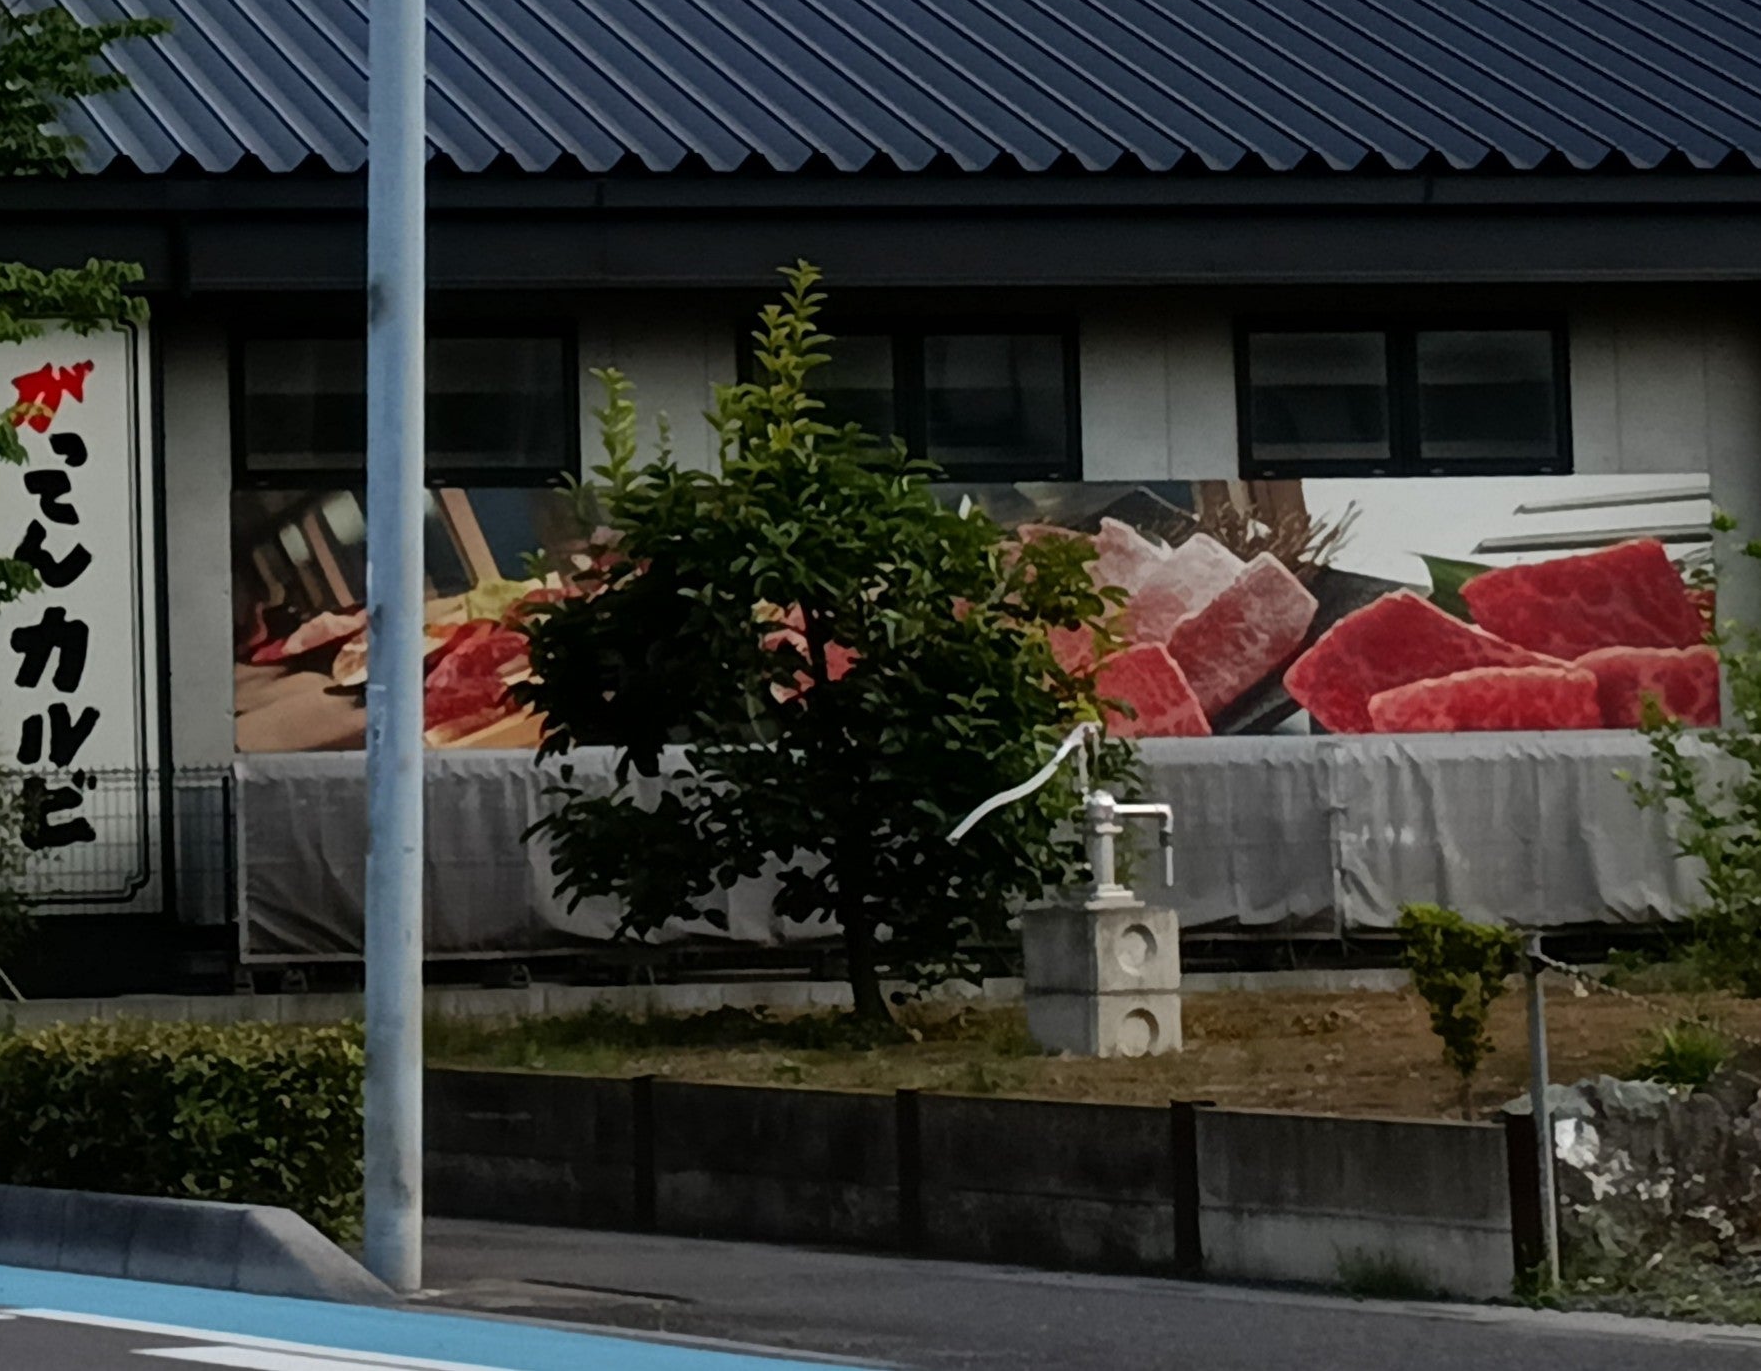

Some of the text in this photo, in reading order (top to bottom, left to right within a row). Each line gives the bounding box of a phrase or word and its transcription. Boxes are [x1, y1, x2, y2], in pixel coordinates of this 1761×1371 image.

[9, 359, 101, 851] がってんカルビ
